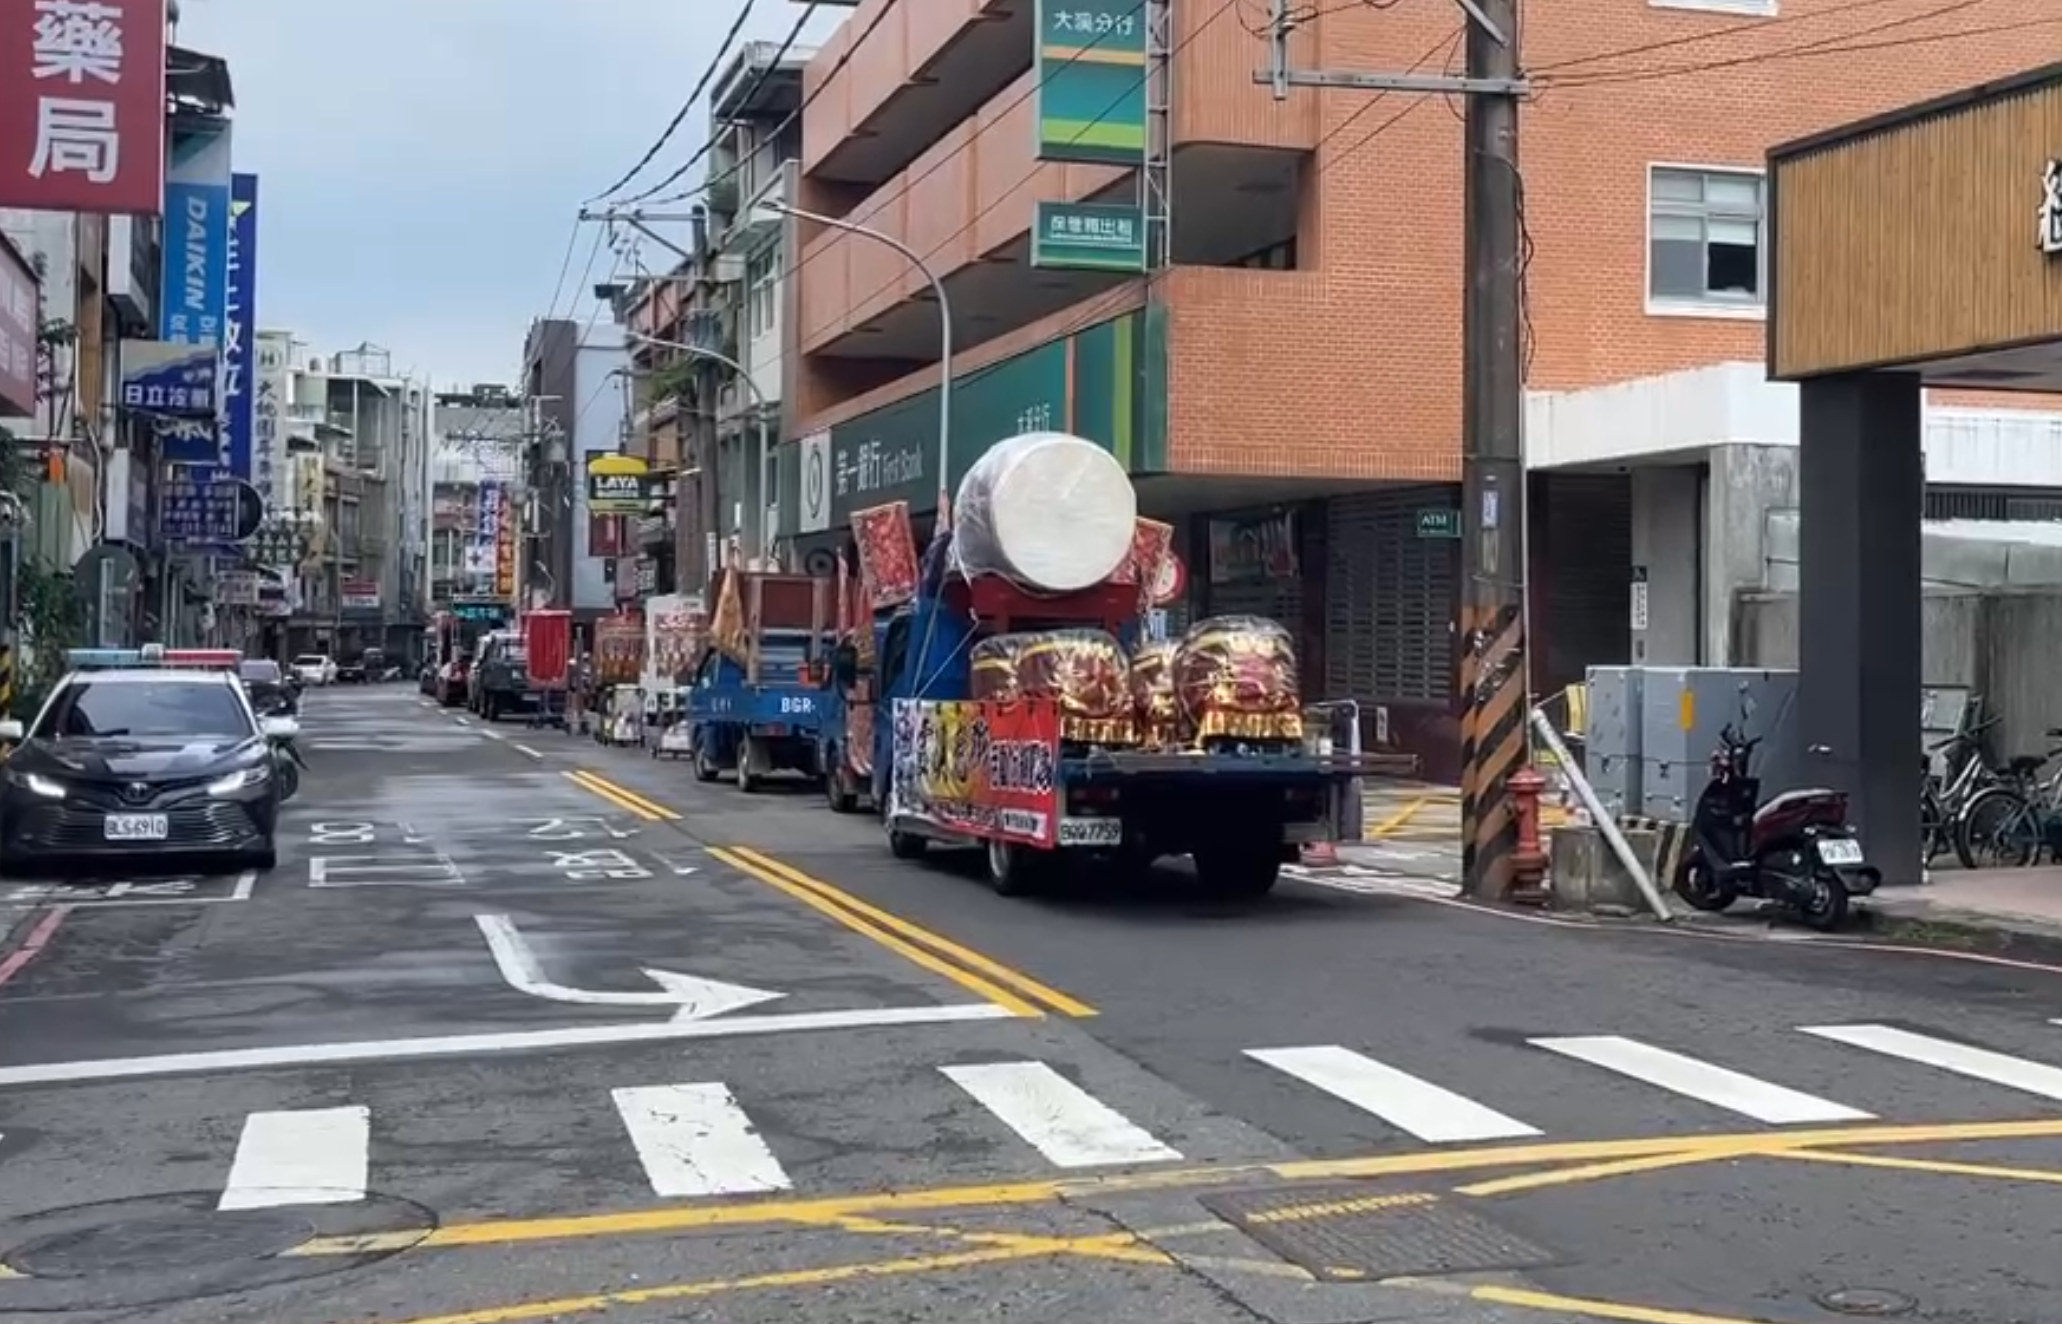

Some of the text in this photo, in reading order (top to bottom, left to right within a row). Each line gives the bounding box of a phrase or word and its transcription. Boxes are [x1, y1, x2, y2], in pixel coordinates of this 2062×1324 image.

[28, 0, 123, 184] 藥局
[185, 197, 208, 310] DAIKIN
[596, 475, 639, 488] LAYA
[837, 441, 923, 495] 第一銀行 First Bank
[1422, 514, 1447, 526] ATM
